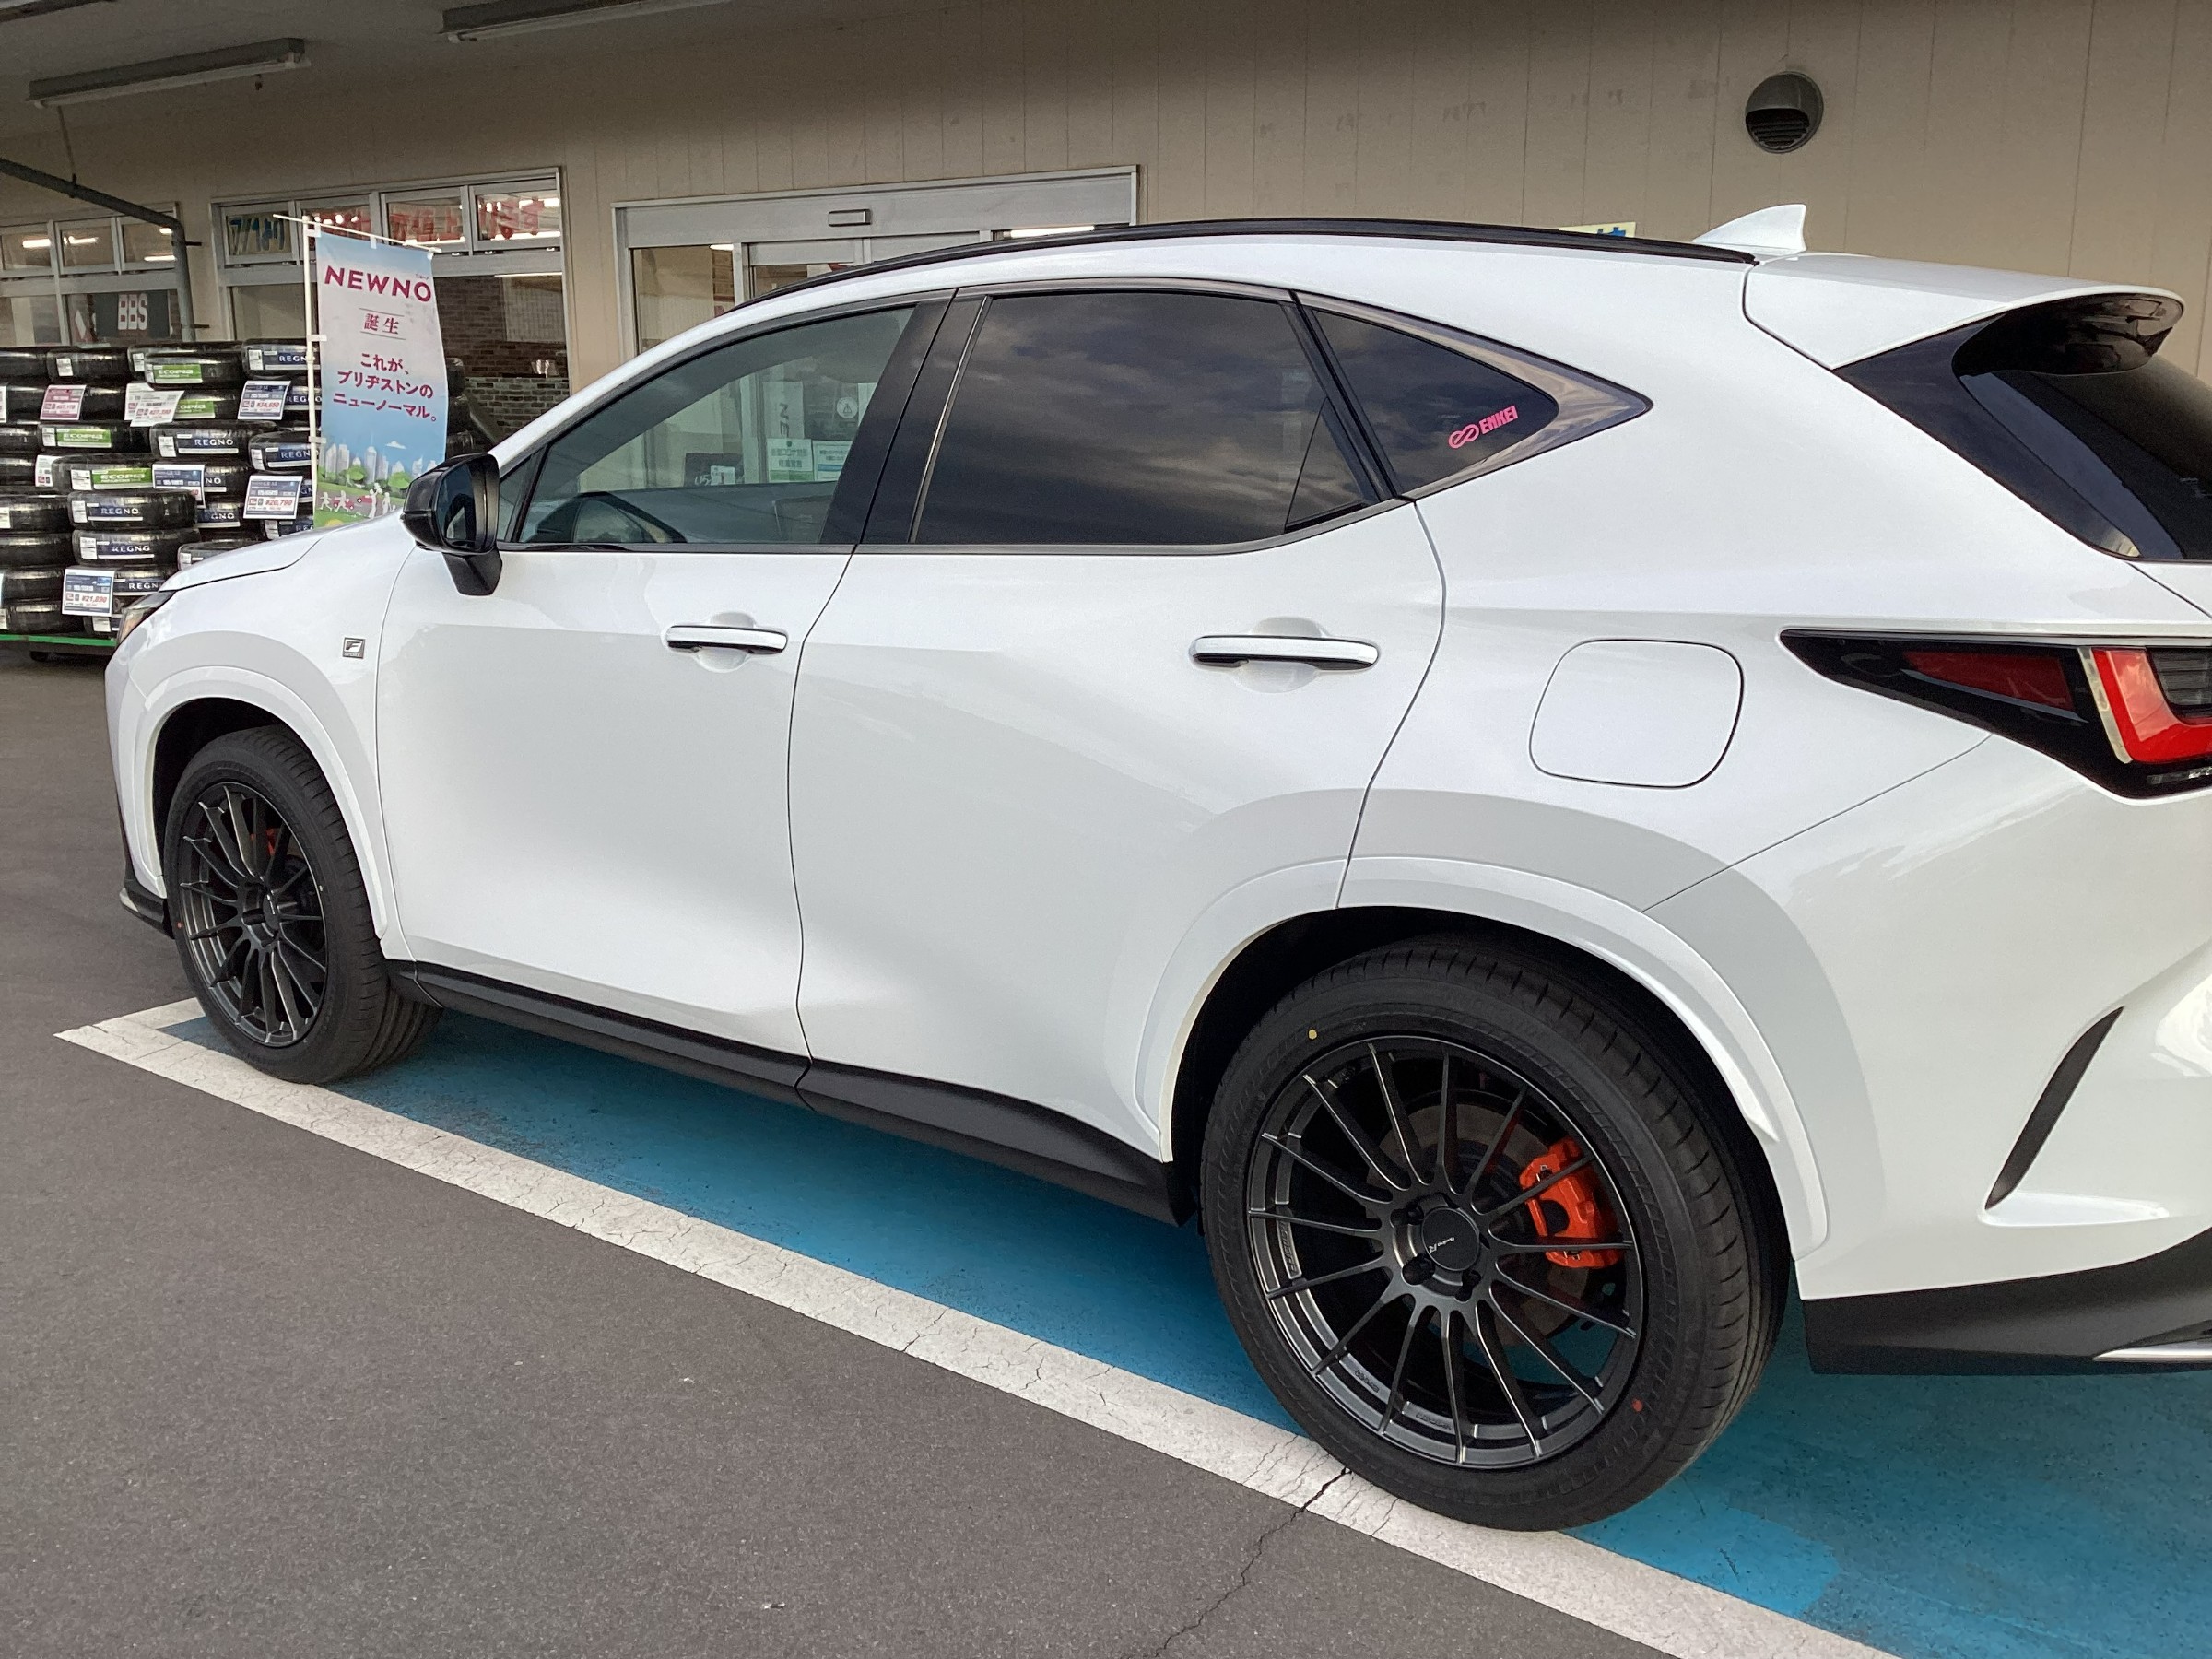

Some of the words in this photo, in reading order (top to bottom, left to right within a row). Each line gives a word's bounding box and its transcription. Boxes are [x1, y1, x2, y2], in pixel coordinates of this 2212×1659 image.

[324, 265, 431, 302] NEWNO
[117, 293, 148, 331] BBS
[363, 312, 400, 335] 誕生
[278, 354, 316, 363] REGN
[360, 352, 409, 375] これが、
[337, 370, 434, 399] ブリヂストンの
[287, 395, 323, 404] REGO
[333, 393, 437, 422] ニューノーマル。
[1478, 405, 1519, 435] ENKEI
[280, 449, 320, 459] REGN
[100, 507, 139, 515] REGNO
